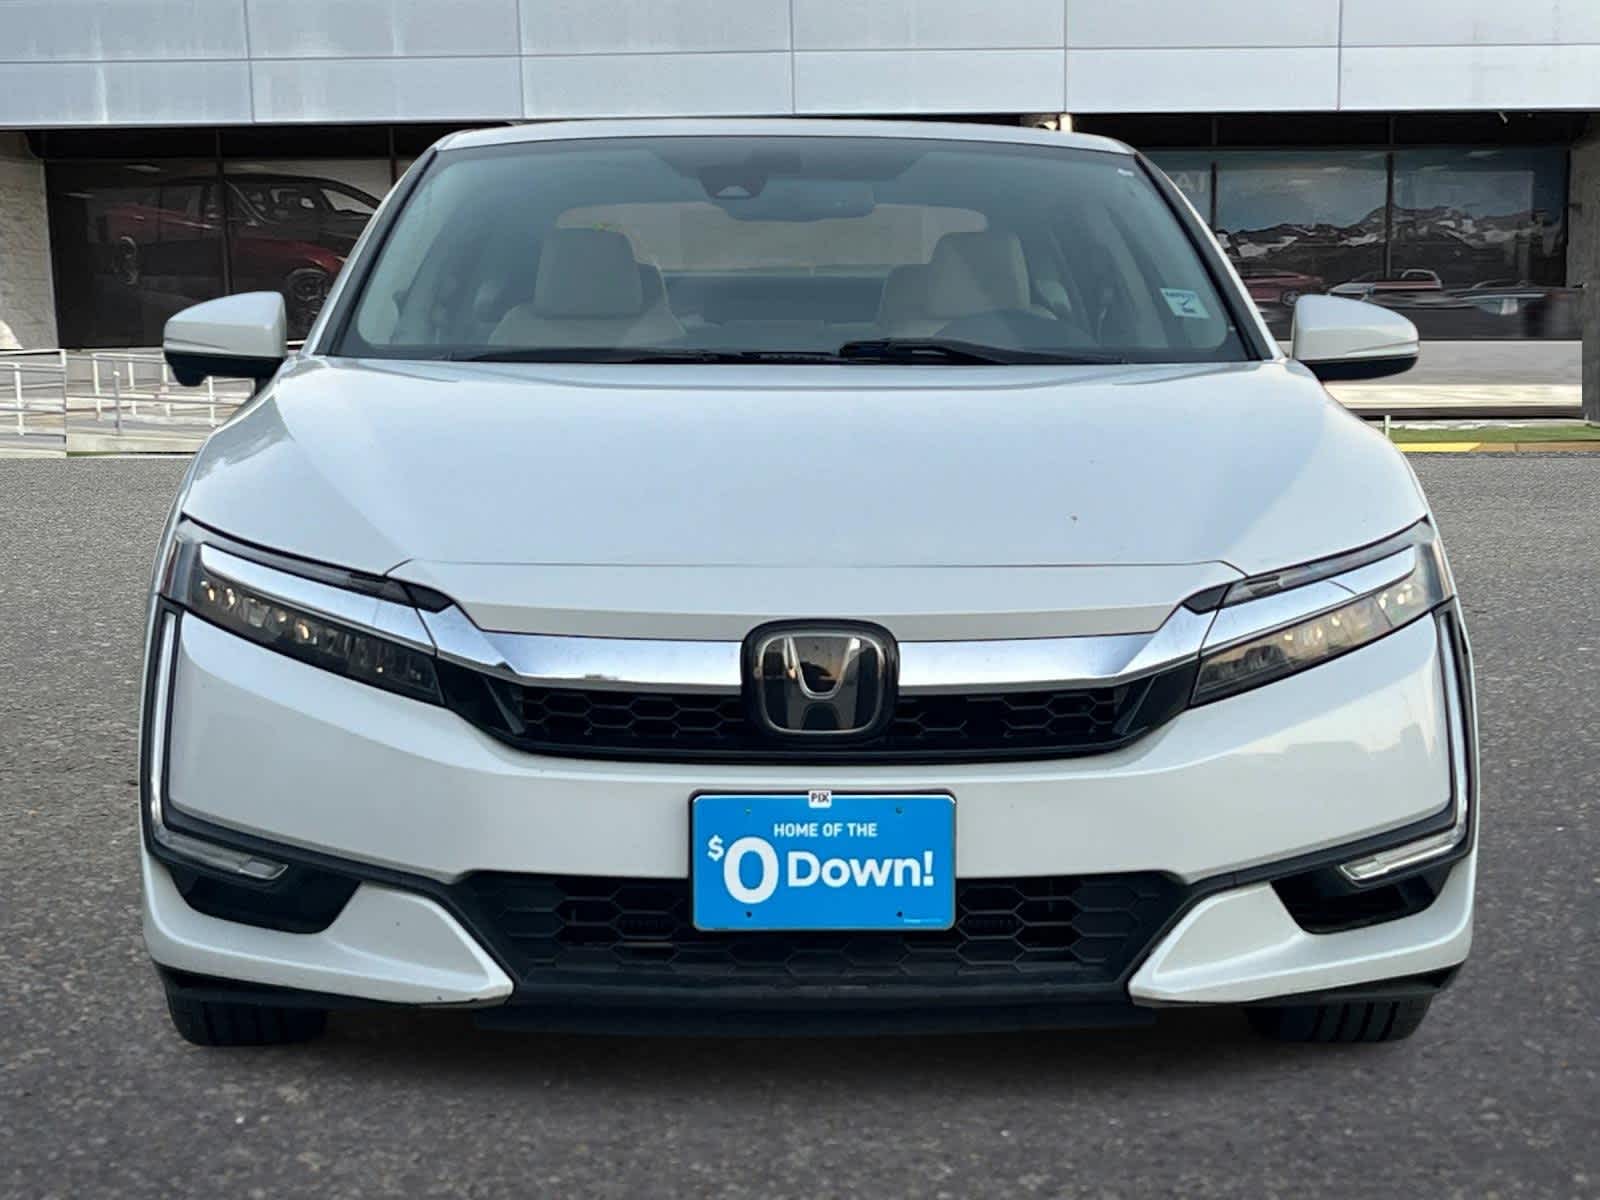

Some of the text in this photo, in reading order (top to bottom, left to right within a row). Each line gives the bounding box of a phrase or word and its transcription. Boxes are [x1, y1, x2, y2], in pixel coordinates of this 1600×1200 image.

[810, 791, 830, 803] PIX
[773, 823, 878, 837] HOME OF THE
[787, 850, 934, 887] Down!
